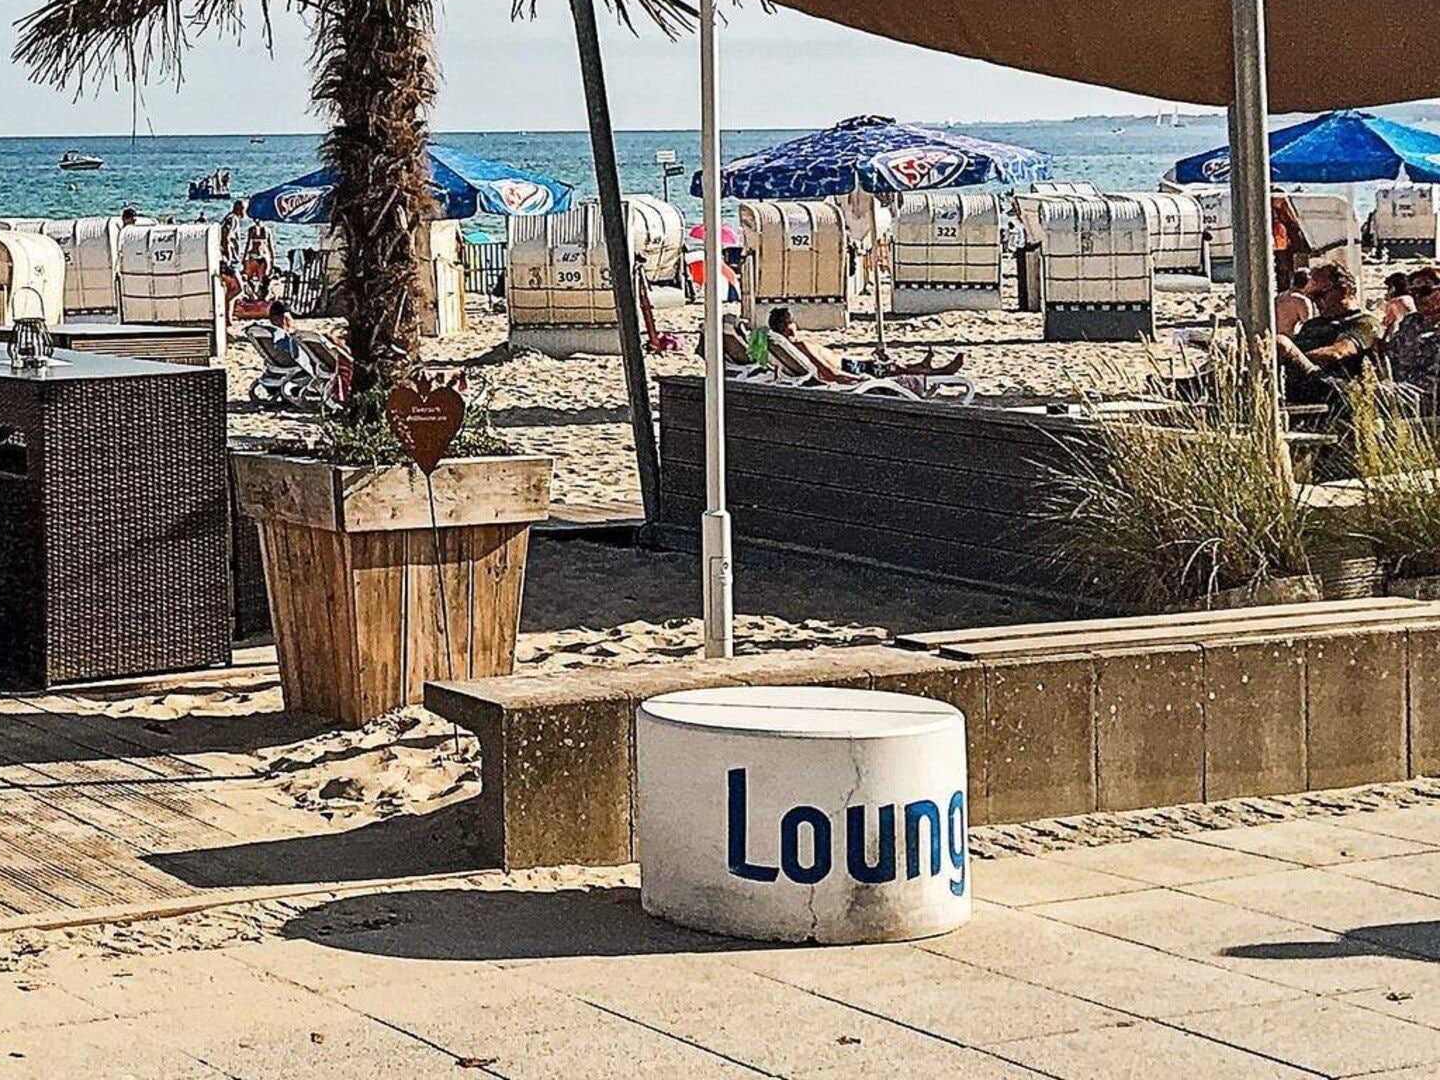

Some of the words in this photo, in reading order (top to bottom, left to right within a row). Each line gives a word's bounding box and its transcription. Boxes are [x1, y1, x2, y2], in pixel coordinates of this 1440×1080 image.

[937, 227, 957, 237] 322
[791, 235, 809, 246] 192
[154, 250, 173, 261] 157
[557, 271, 581, 282] 309
